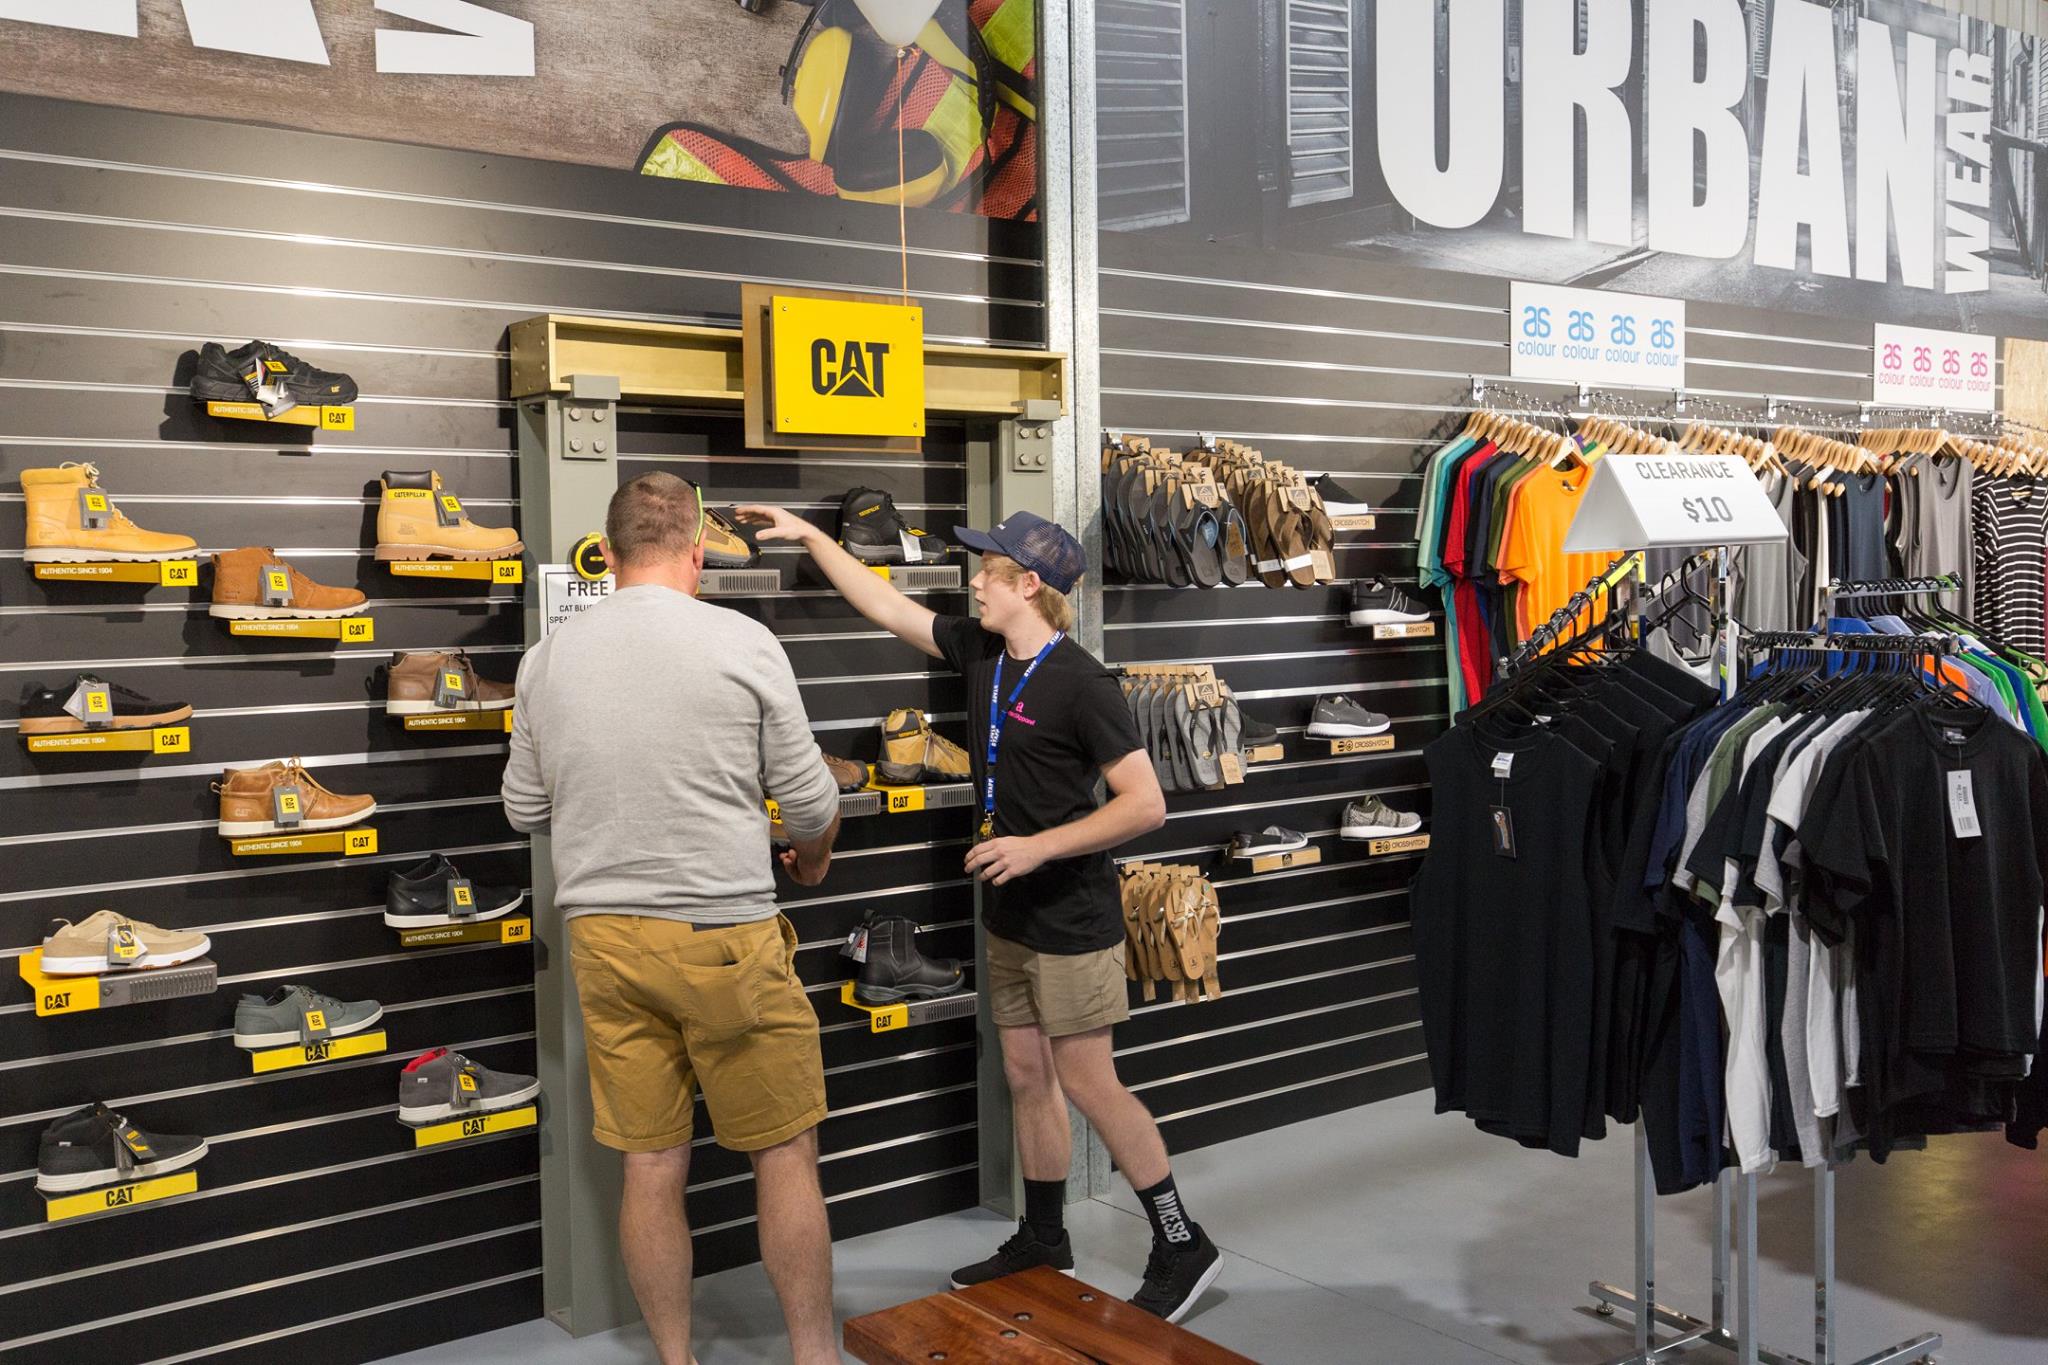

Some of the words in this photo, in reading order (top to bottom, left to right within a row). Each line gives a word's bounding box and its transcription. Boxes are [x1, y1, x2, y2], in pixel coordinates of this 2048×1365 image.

[1376, 0, 1937, 292] URBAN
[1944, 47, 1992, 294] WEAR
[1517, 340, 1557, 357] colour
[1562, 344, 1599, 360] colour
[1605, 348, 1640, 364] colour
[1646, 351, 1679, 367] colour
[811, 338, 890, 398] CAT
[1879, 372, 1906, 385] colour
[1909, 375, 1935, 388] colour
[1938, 377, 1964, 390] colour
[1967, 379, 1991, 392] colour
[213, 405, 246, 414] AUTHENTIC
[328, 412, 346, 424] CAT
[1635, 461, 1734, 480] CLEARANCE
[393, 491, 426, 499] CATERPILLAR
[1682, 496, 1734, 523] $10
[40, 567, 77, 575] AUTHENTIC
[169, 568, 189, 580] CAT
[394, 564, 425, 572] AUTHENTIC
[499, 566, 515, 577] CAT
[567, 581, 609, 597] FREE
[559, 604, 572, 613] CAT
[234, 624, 268, 632] AUTHENTIC
[268, 624, 286, 632] SINCE
[348, 624, 366, 636] CAT
[1024, 660, 1037, 677] STAFF
[408, 719, 438, 727] AUTHENTIC
[33, 738, 70, 748] AUTHENTIC
[70, 737, 91, 746] SINCE
[91, 736, 106, 744] 1904
[162, 734, 181, 746] CAT
[1354, 739, 1390, 749] CROSSHATCH
[893, 796, 909, 809] CAT
[234, 808, 250, 817] CAT
[770, 808, 781, 820] CA
[237, 843, 271, 852] AUTHENTIC
[270, 841, 289, 849] SINCE
[289, 840, 303, 848] 1904
[352, 836, 370, 848] CAT
[1391, 839, 1426, 849] CROSSHATCH
[405, 933, 434, 943] AUTHENTIC
[434, 931, 452, 939] SINCE
[508, 925, 524, 937] CAT
[44, 992, 72, 1010] CAT
[876, 1014, 893, 1029] CAT
[304, 1043, 331, 1062] CAT
[462, 1117, 487, 1136] CAT
[105, 1186, 134, 1207] CAT
